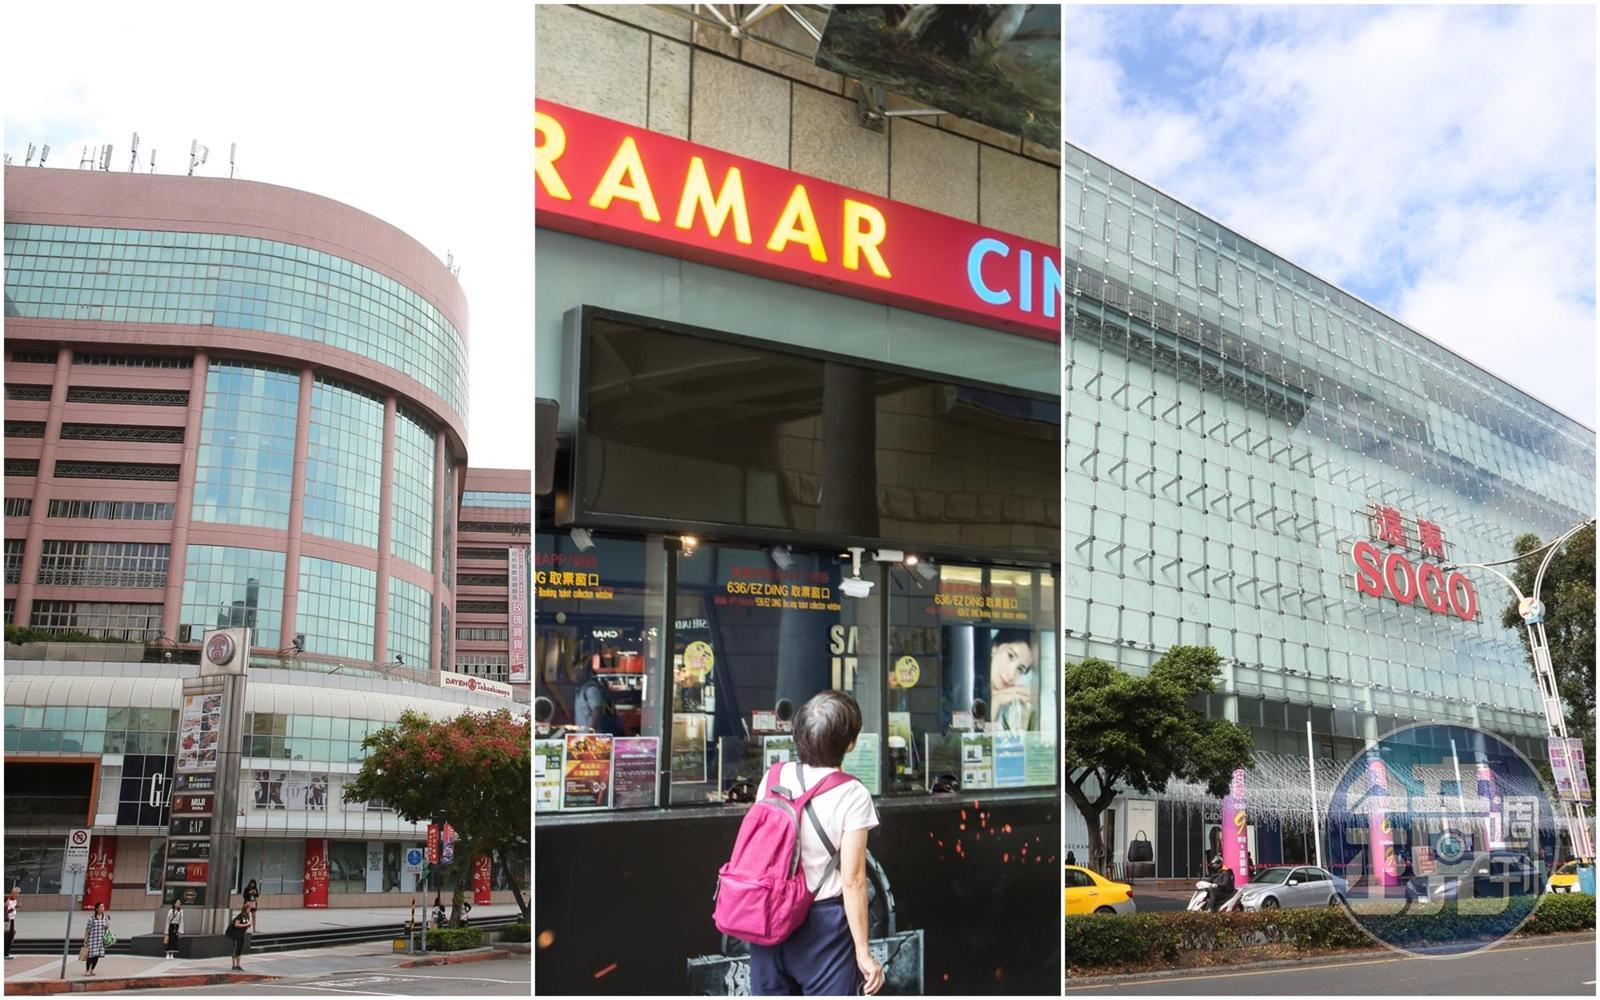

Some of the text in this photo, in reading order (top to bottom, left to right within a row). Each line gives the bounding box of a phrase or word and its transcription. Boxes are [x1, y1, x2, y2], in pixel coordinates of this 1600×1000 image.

[535, 111, 892, 279] RAMAR
[1374, 503, 1446, 561] 遠東
[549, 571, 599, 586] 取票窗口
[1352, 540, 1478, 621] SOGO
[727, 582, 830, 599] 636/EZ DING 取票窗口
[445, 677, 468, 687] DAYEH
[191, 798, 206, 806] MUJI
[189, 820, 203, 833] GAP
